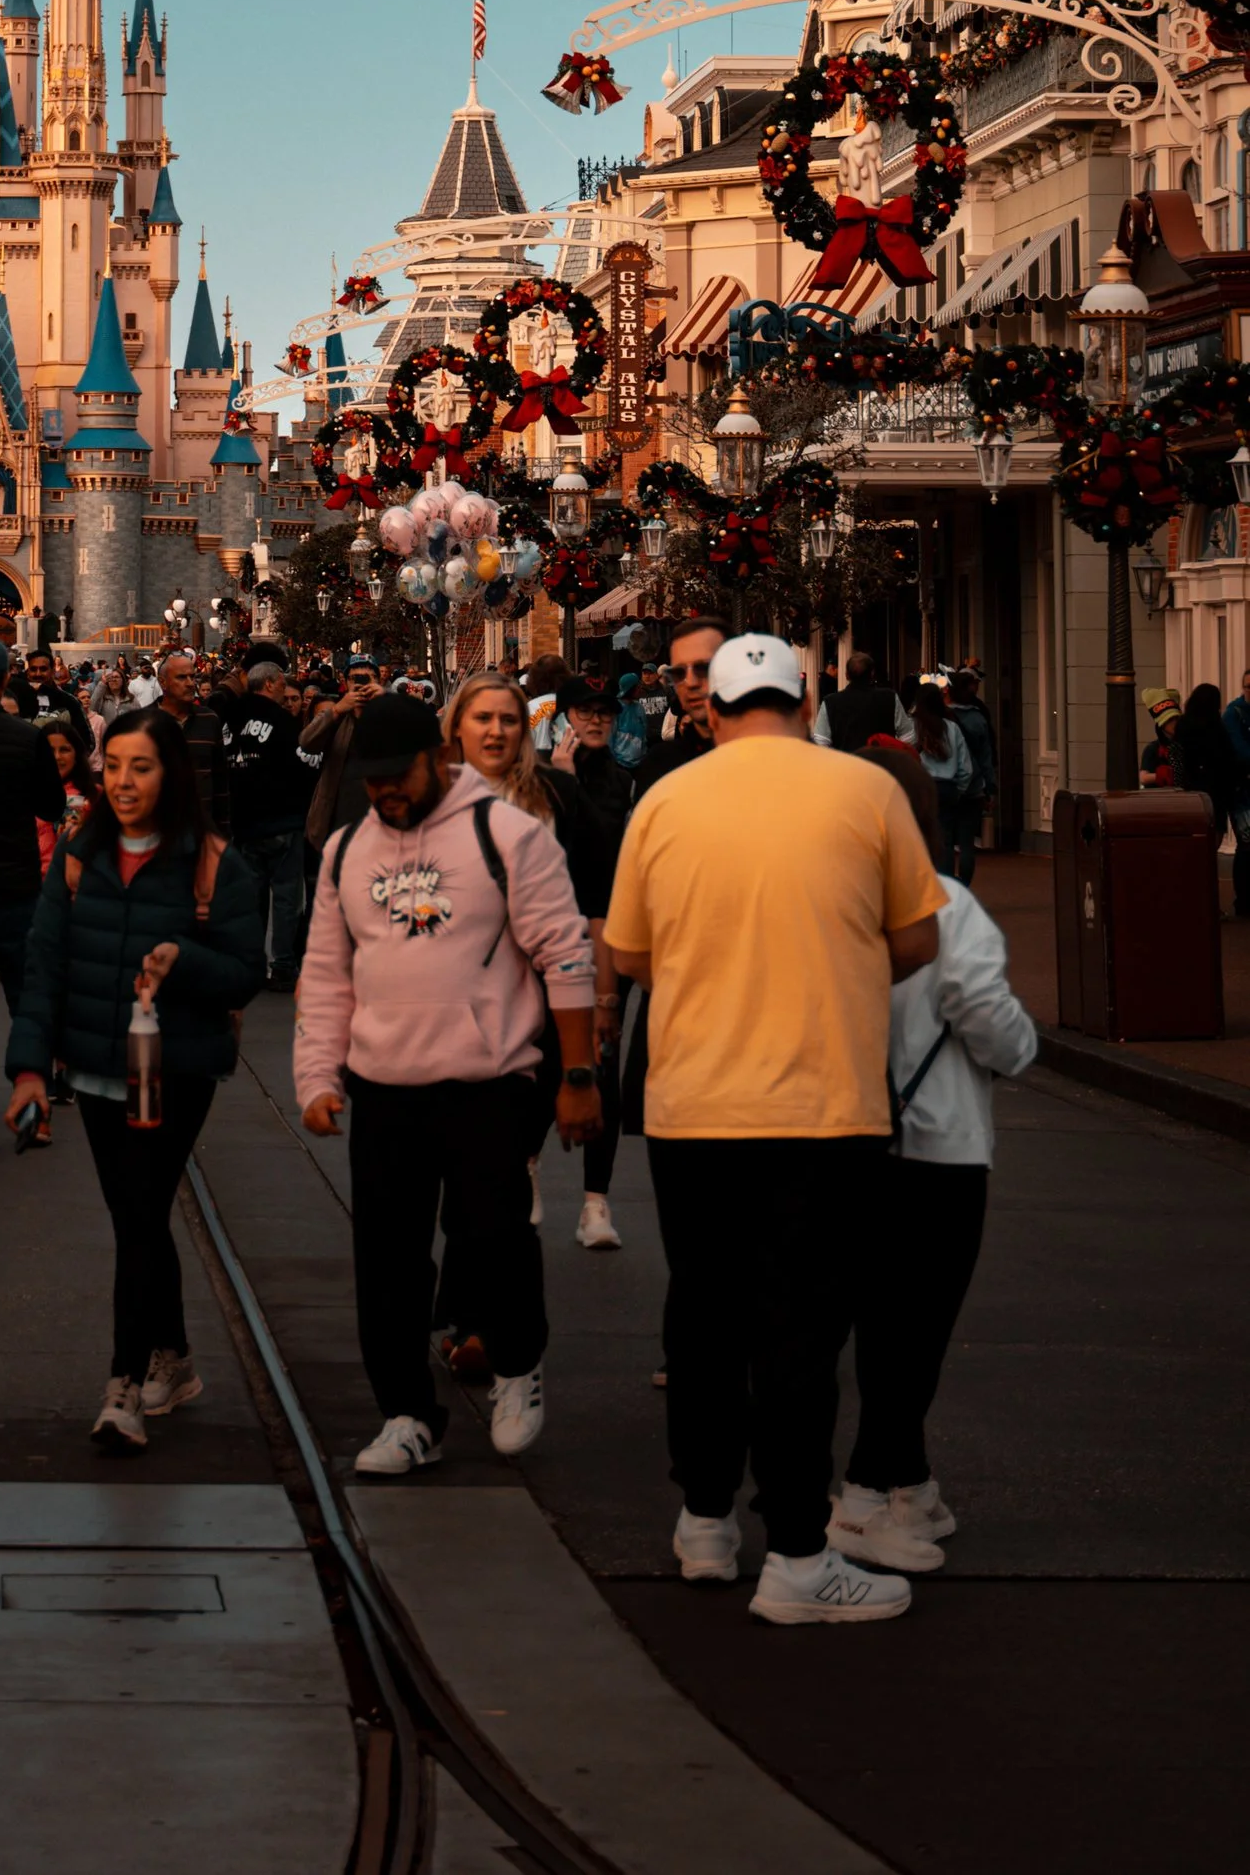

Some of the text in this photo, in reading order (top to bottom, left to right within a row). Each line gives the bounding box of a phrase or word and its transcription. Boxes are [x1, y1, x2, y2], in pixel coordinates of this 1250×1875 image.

[618, 271, 638, 423] CRYSTAL ARTS
[1167, 343, 1199, 373] SHOWING
